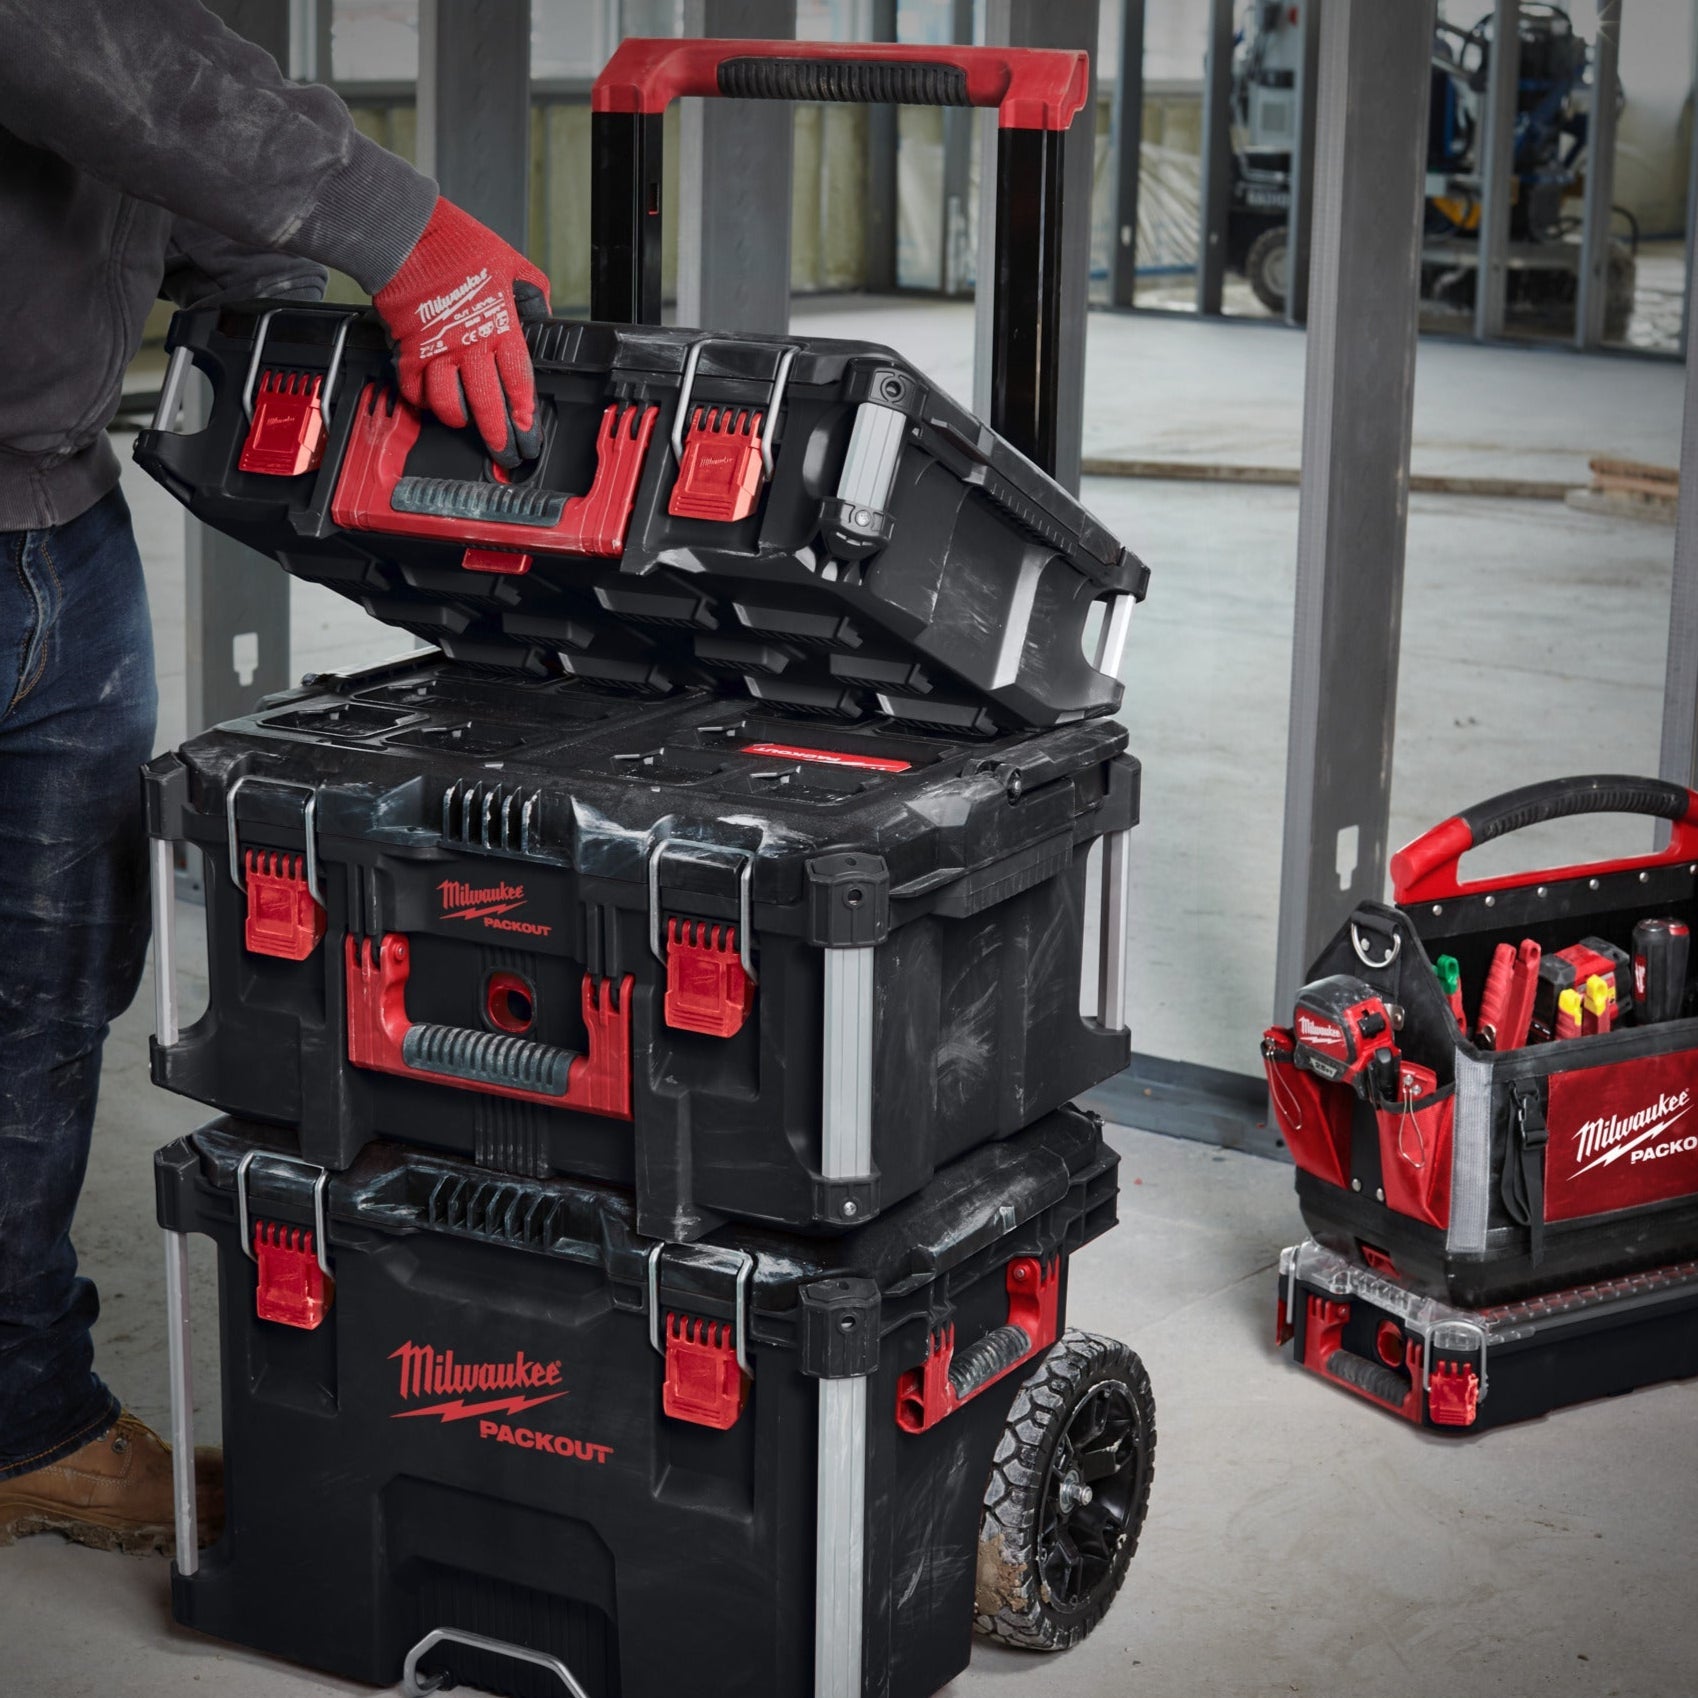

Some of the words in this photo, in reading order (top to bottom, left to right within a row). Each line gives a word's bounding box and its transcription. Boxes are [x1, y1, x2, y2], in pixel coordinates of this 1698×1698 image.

[415, 268, 487, 323] Milwaukee
[461, 330, 479, 345] CE
[436, 879, 525, 910] Milwaukee
[483, 917, 552, 936] PACKOUT
[1298, 1016, 1341, 1039] Milwaukee
[1571, 1090, 1691, 1164] Milwaukee
[386, 1339, 563, 1400] Milwaukee
[479, 1419, 614, 1464] PACKOUT
